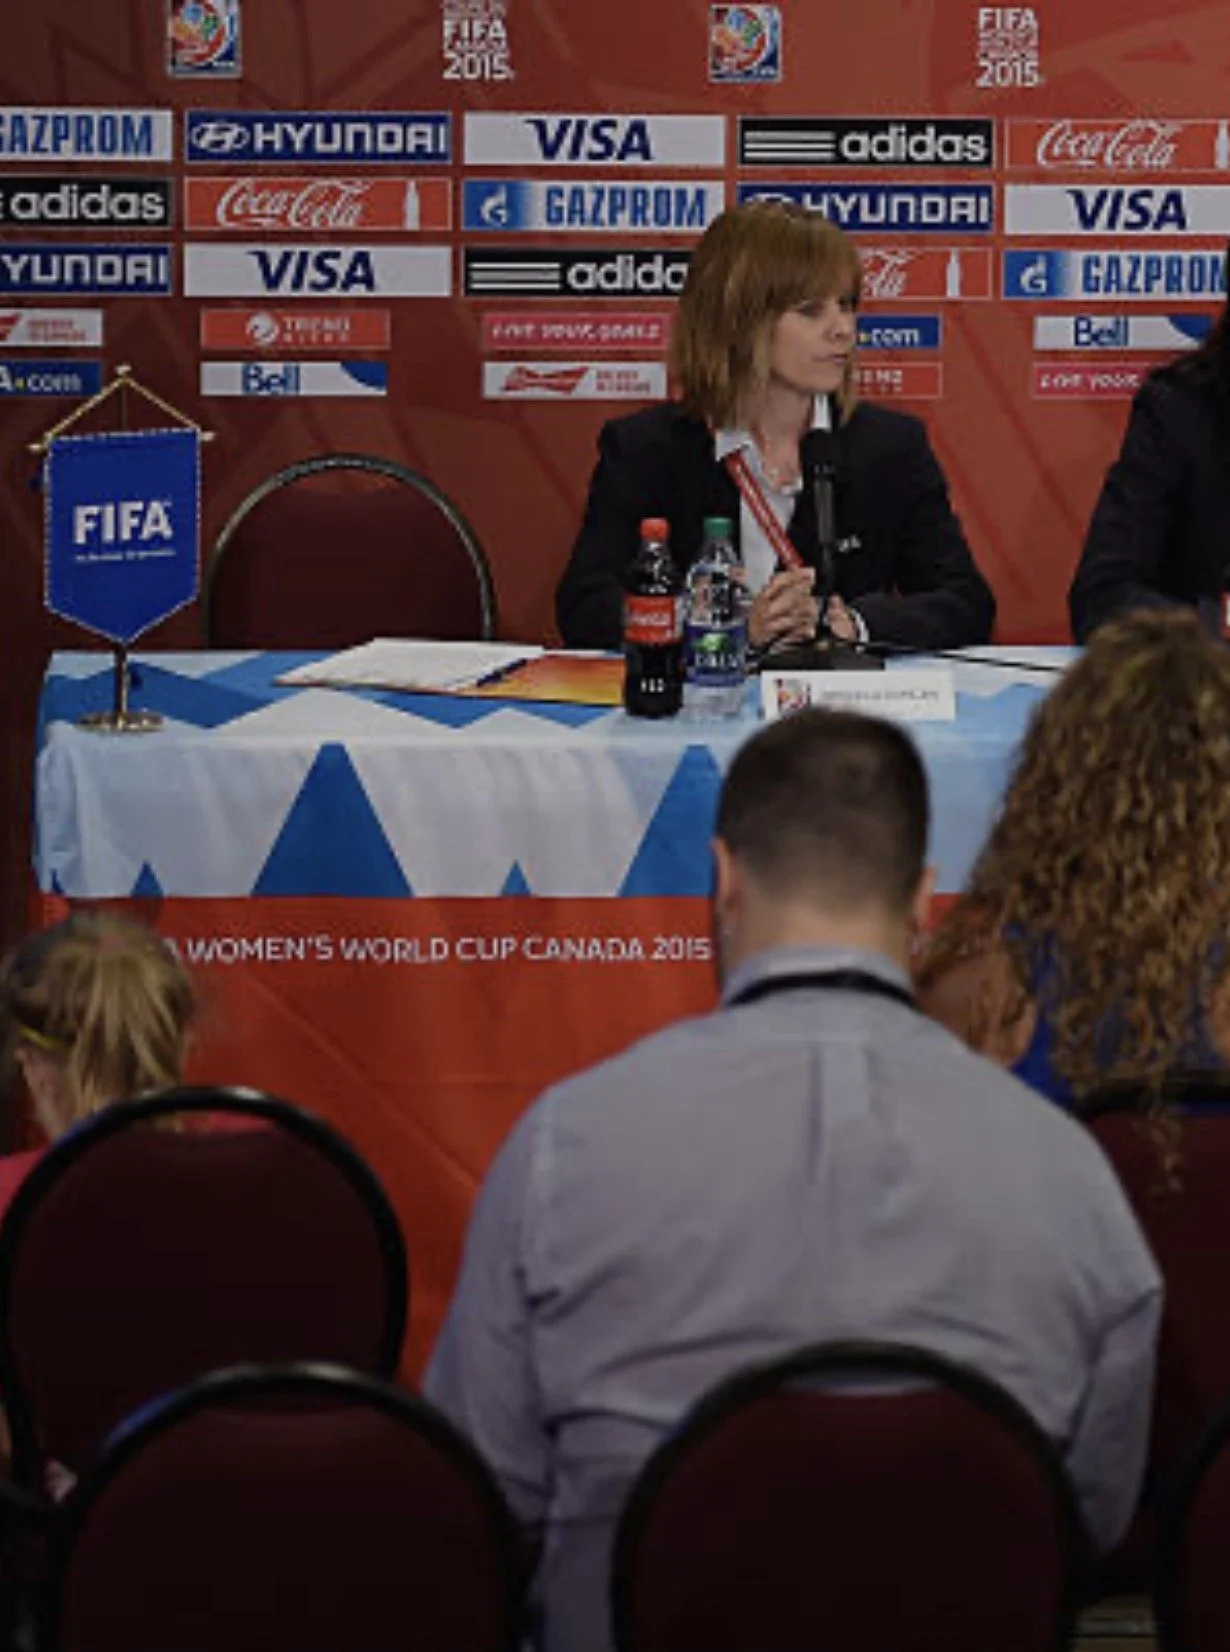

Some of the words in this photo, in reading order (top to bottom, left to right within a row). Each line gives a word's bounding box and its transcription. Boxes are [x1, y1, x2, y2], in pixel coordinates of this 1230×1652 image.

[443, 19, 507, 39] FIFA
[978, 8, 1038, 30] FIFA
[442, 53, 509, 80] 2015
[976, 61, 1039, 88] 2015
[0, 114, 153, 156] AZPROM
[254, 123, 446, 152] HYUNDAI
[525, 119, 653, 161] VISA
[841, 125, 986, 163] adidas
[10, 184, 164, 221] adidas
[545, 188, 705, 228] GAZPROM
[1065, 190, 1187, 231] VISA
[0, 254, 168, 285] YUNDAI
[248, 252, 375, 291] VISA
[567, 258, 688, 293] adida
[1074, 316, 1129, 346] Bell
[241, 363, 299, 393] Bell
[75, 500, 173, 544] FIFA
[187, 933, 334, 964] WOMEN'S
[340, 935, 446, 963] WORLD
[456, 935, 518, 962] CUP
[522, 936, 646, 962] CANADA
[651, 936, 712, 961] 2015
